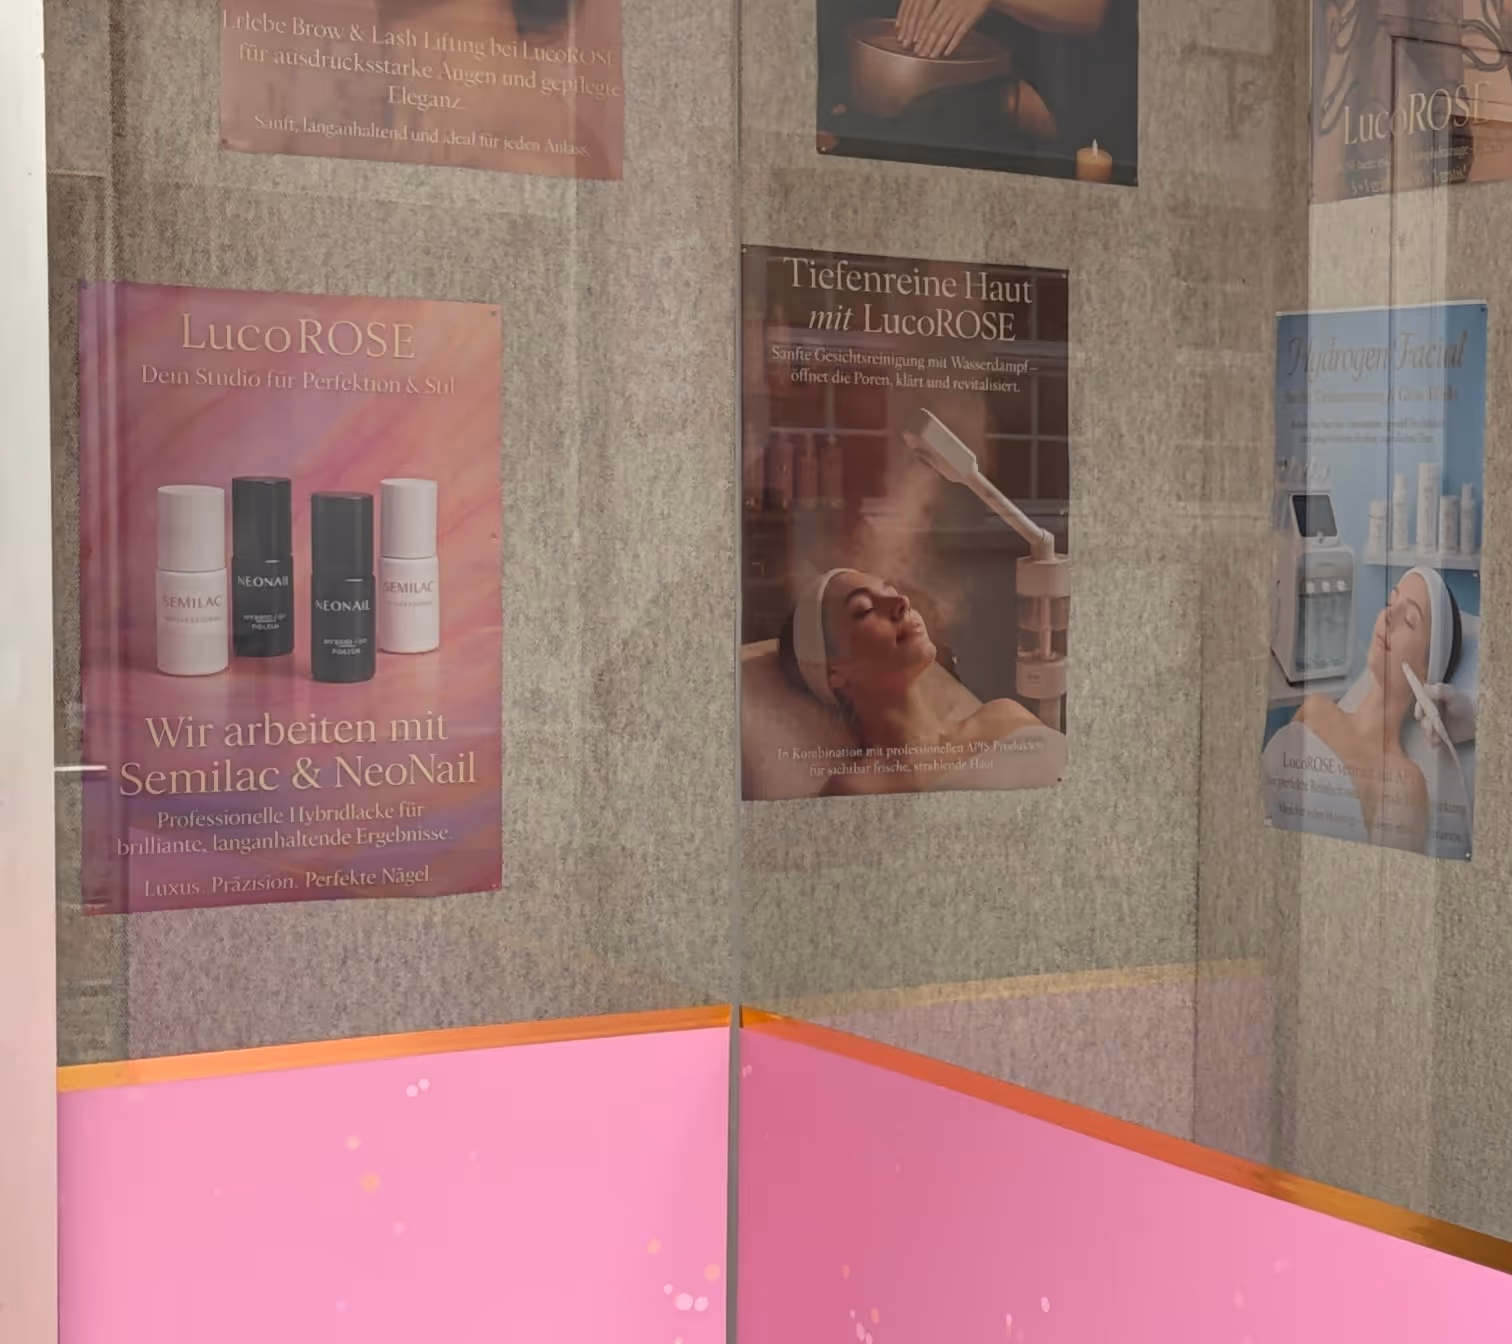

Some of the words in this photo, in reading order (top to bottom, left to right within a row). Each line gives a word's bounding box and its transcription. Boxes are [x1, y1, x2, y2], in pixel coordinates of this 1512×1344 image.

[292, 16, 346, 41] Brow
[349, 23, 364, 43] &
[372, 25, 418, 49] Lash
[273, 48, 434, 80] ausdrucksstarke
[440, 60, 497, 88] Augen
[502, 70, 537, 90] und
[1343, 80, 1493, 146] LucoROSE
[302, 115, 408, 142] langanhaltend
[783, 256, 957, 299] Tiefenreine
[964, 269, 1033, 304] Haut
[182, 311, 416, 360] LucoROSE
[808, 304, 853, 331] mit
[863, 302, 1017, 343] LucoROSE
[771, 344, 812, 361] Sanfte
[814, 346, 925, 370] Gesichtsreinigung
[928, 354, 948, 369] mit
[141, 364, 189, 386] Dein
[195, 366, 262, 389] Studio
[267, 369, 295, 390] für
[303, 371, 400, 394] Perfektion
[405, 376, 421, 394] &
[424, 376, 456, 395] Stil
[791, 364, 828, 382] öffnet
[832, 369, 850, 383] die
[896, 372, 924, 389] klärt
[927, 375, 949, 390] und
[162, 594, 224, 609] SEMILAC
[383, 580, 434, 594] SEMILAC
[315, 599, 371, 611] NEONAIL
[145, 715, 214, 749] Wir
[224, 712, 377, 747] arbeiten
[390, 710, 449, 742] mit
[120, 759, 280, 796] Semilac
[292, 757, 323, 790] &
[334, 751, 478, 789] NeoNail
[157, 807, 284, 829] Professionelle
[289, 802, 394, 826] Hybridlacke
[399, 800, 425, 818] für
[213, 827, 352, 854] langanhaltende
[305, 867, 377, 888] Perfekte
